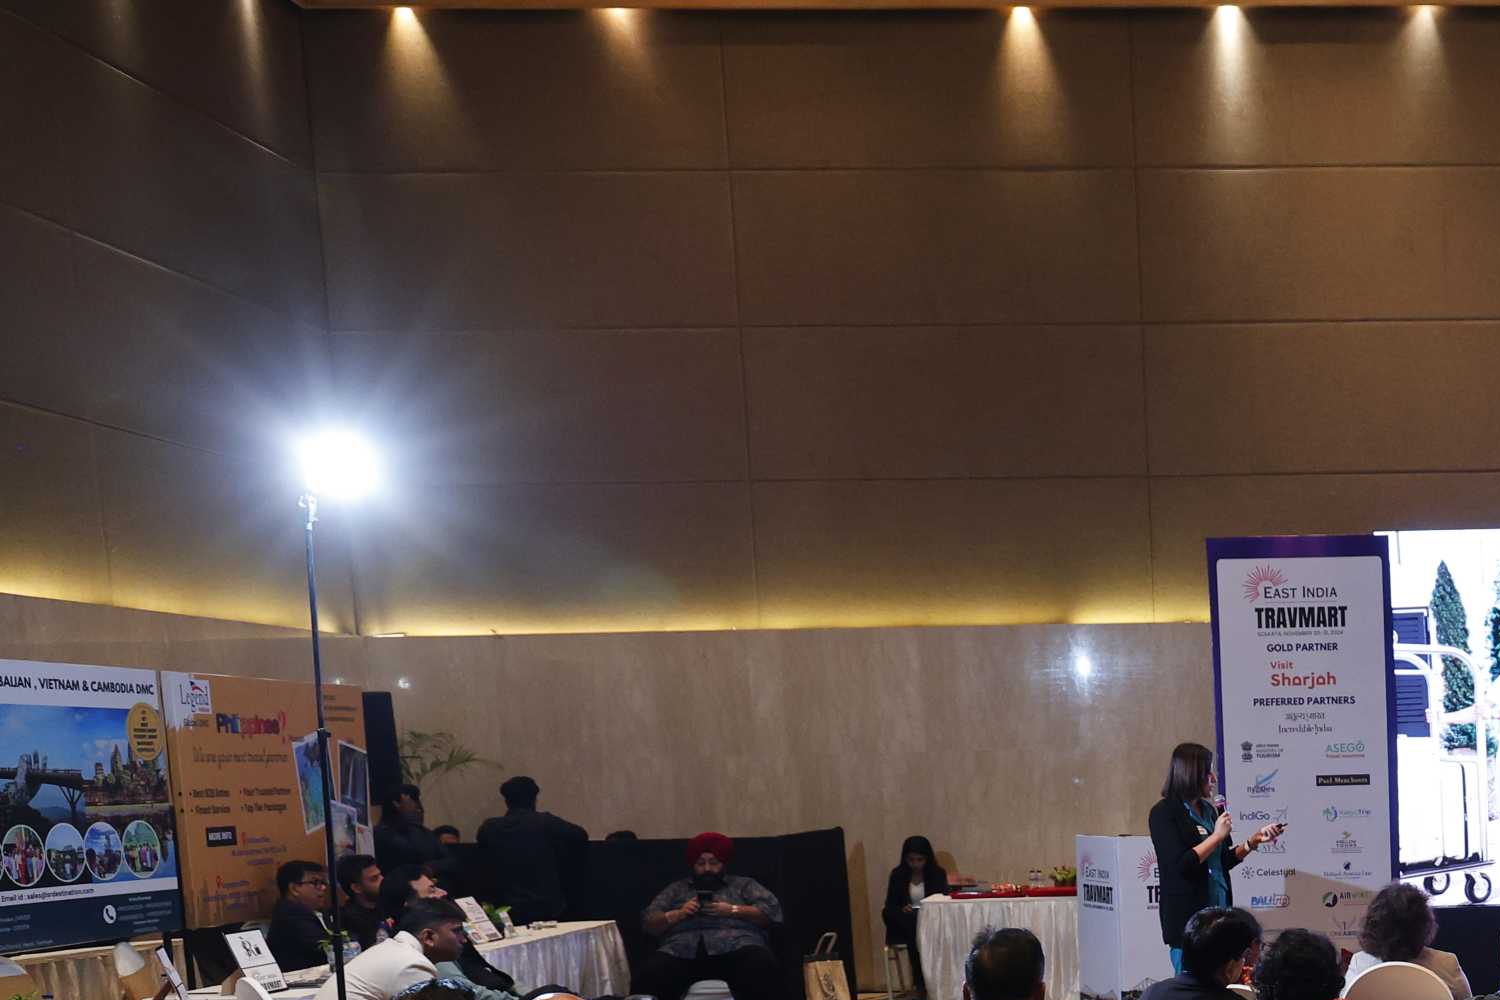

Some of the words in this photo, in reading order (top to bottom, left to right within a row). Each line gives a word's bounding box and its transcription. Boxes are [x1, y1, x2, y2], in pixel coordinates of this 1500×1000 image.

[1264, 586, 1297, 599] EAST
[1302, 586, 1338, 599] INDIA
[1255, 606, 1347, 629] TRAVMART
[1266, 643, 1293, 653] GOLD
[1295, 642, 1338, 652] PARTNER
[1270, 660, 1294, 669] Visit
[1270, 671, 1337, 689] Sharjah
[38, 678, 80, 692] VIETNAM
[82, 680, 89, 692] &
[90, 681, 135, 694] CAMBODIA
[136, 684, 154, 695] DMC
[1253, 697, 1305, 707] PREFERRED
[1307, 695, 1356, 705] PARTNERS
[1239, 810, 1271, 821] IndiGo
[208, 832, 222, 841] MORE
[222, 831, 233, 840] INFO
[1083, 884, 1113, 905] TRAVMART
